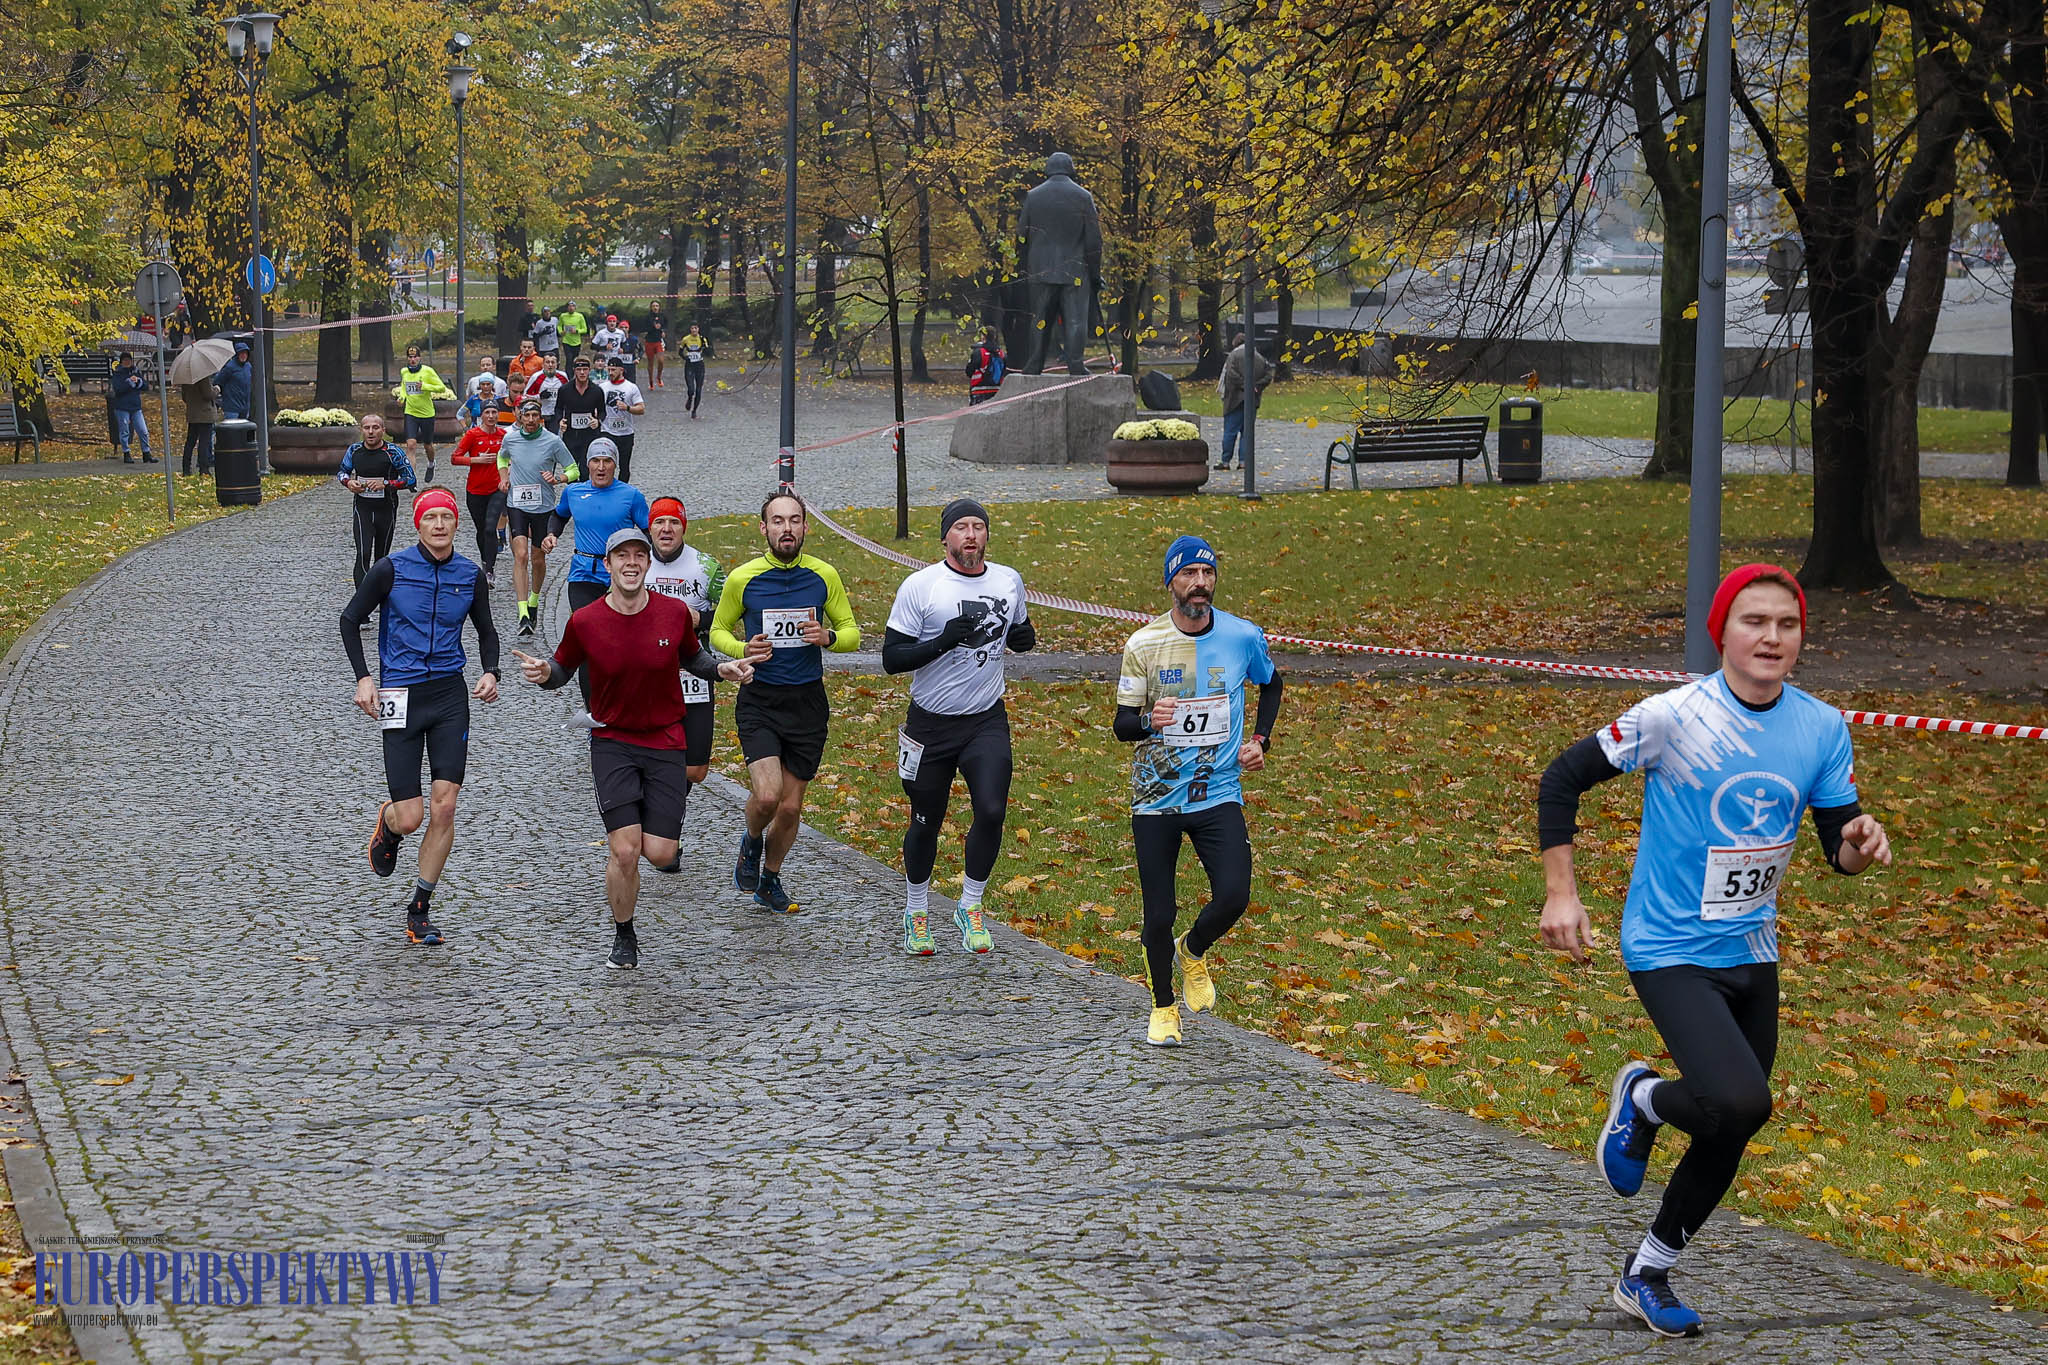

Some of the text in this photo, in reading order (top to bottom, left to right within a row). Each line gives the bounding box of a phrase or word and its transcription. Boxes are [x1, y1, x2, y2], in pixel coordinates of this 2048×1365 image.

[520, 491, 533, 500] 43
[1160, 676, 1184, 685] TEAM
[1183, 713, 1209, 734] 67
[1723, 865, 1777, 898] 538
